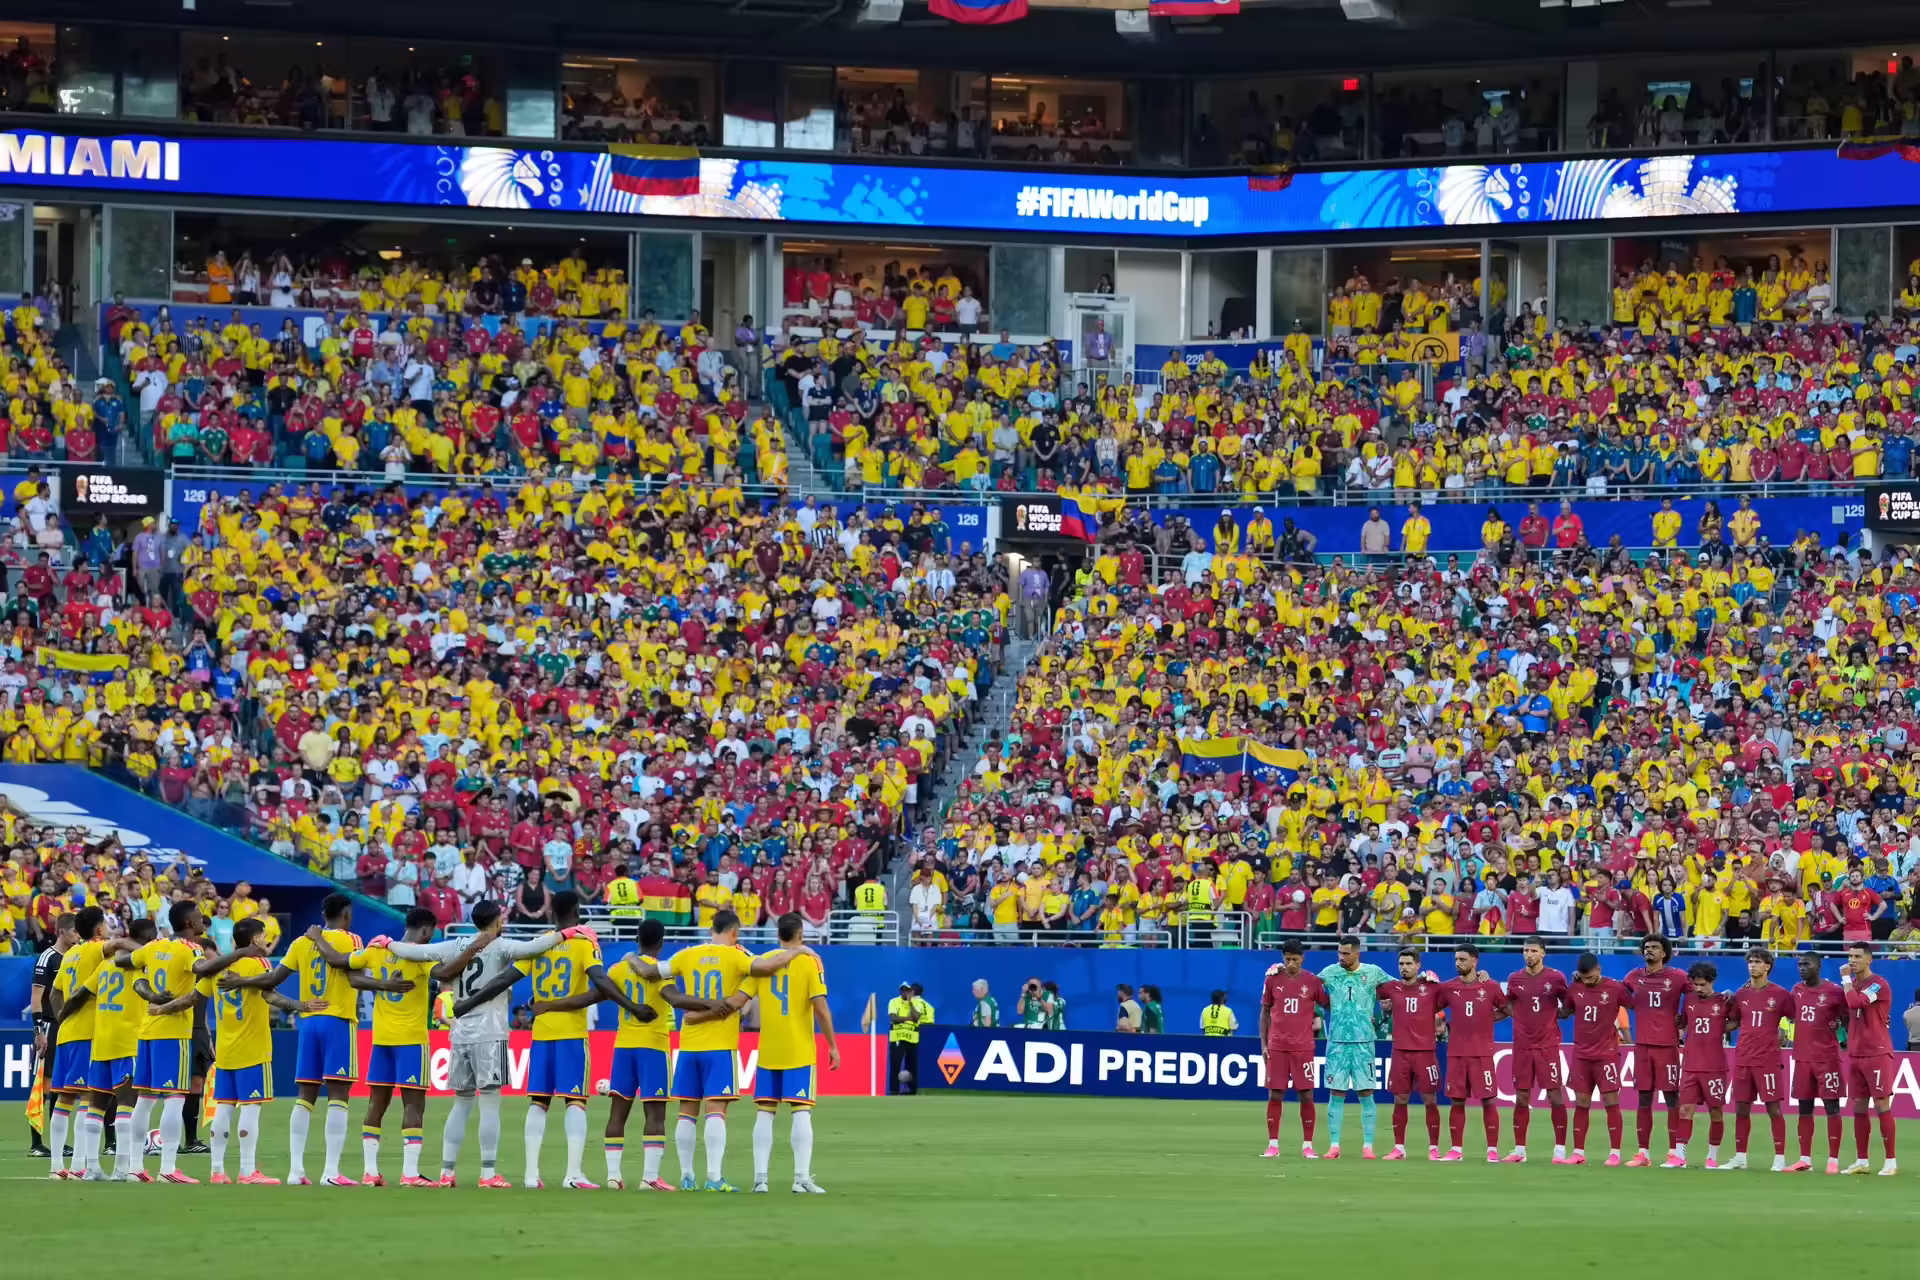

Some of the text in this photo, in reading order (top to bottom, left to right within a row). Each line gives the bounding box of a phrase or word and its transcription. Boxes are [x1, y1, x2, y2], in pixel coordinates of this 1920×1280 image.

[0, 133, 180, 181] MIAMI
[1016, 186, 1209, 227] #FIFAWorldCup
[90, 475, 113, 485] FIFA
[89, 484, 128, 494] WORLD
[183, 489, 206, 502] 126
[1892, 492, 1912, 501] FIFA
[89, 494, 110, 503] CUP
[1028, 505, 1050, 514] FIFA
[1844, 505, 1865, 517] 129
[1891, 510, 1911, 520] CUP
[957, 513, 979, 526] 126
[1028, 514, 1062, 523] WORLD
[1028, 523, 1048, 531] CUP
[1349, 908, 1354, 917] 7
[309, 956, 327, 997] 3
[535, 956, 572, 999] 23
[692, 969, 723, 1000] 10
[770, 975, 789, 1016] 4
[1347, 986, 1353, 1002] 1
[1648, 991, 1661, 1007] 13
[1283, 998, 1299, 1014] 20
[1404, 997, 1418, 1013] 18
[1466, 1001, 1474, 1017] 8
[1531, 997, 1540, 1012] 3
[1584, 1005, 1598, 1022] 21
[1751, 1011, 1763, 1027] 11
[1801, 1006, 1816, 1022] 25
[1696, 1017, 1709, 1034] 23
[973, 1040, 1084, 1085] ADI
[1549, 1063, 1558, 1078] 3
[1425, 1065, 1439, 1082] 18
[1483, 1070, 1493, 1086] 8
[1603, 1062, 1618, 1081] 21
[1666, 1064, 1677, 1081] 13
[1873, 1069, 1881, 1086] 7
[1708, 1078, 1727, 1096] 23
[1763, 1073, 1777, 1090] 11
[1824, 1073, 1841, 1089] 25
